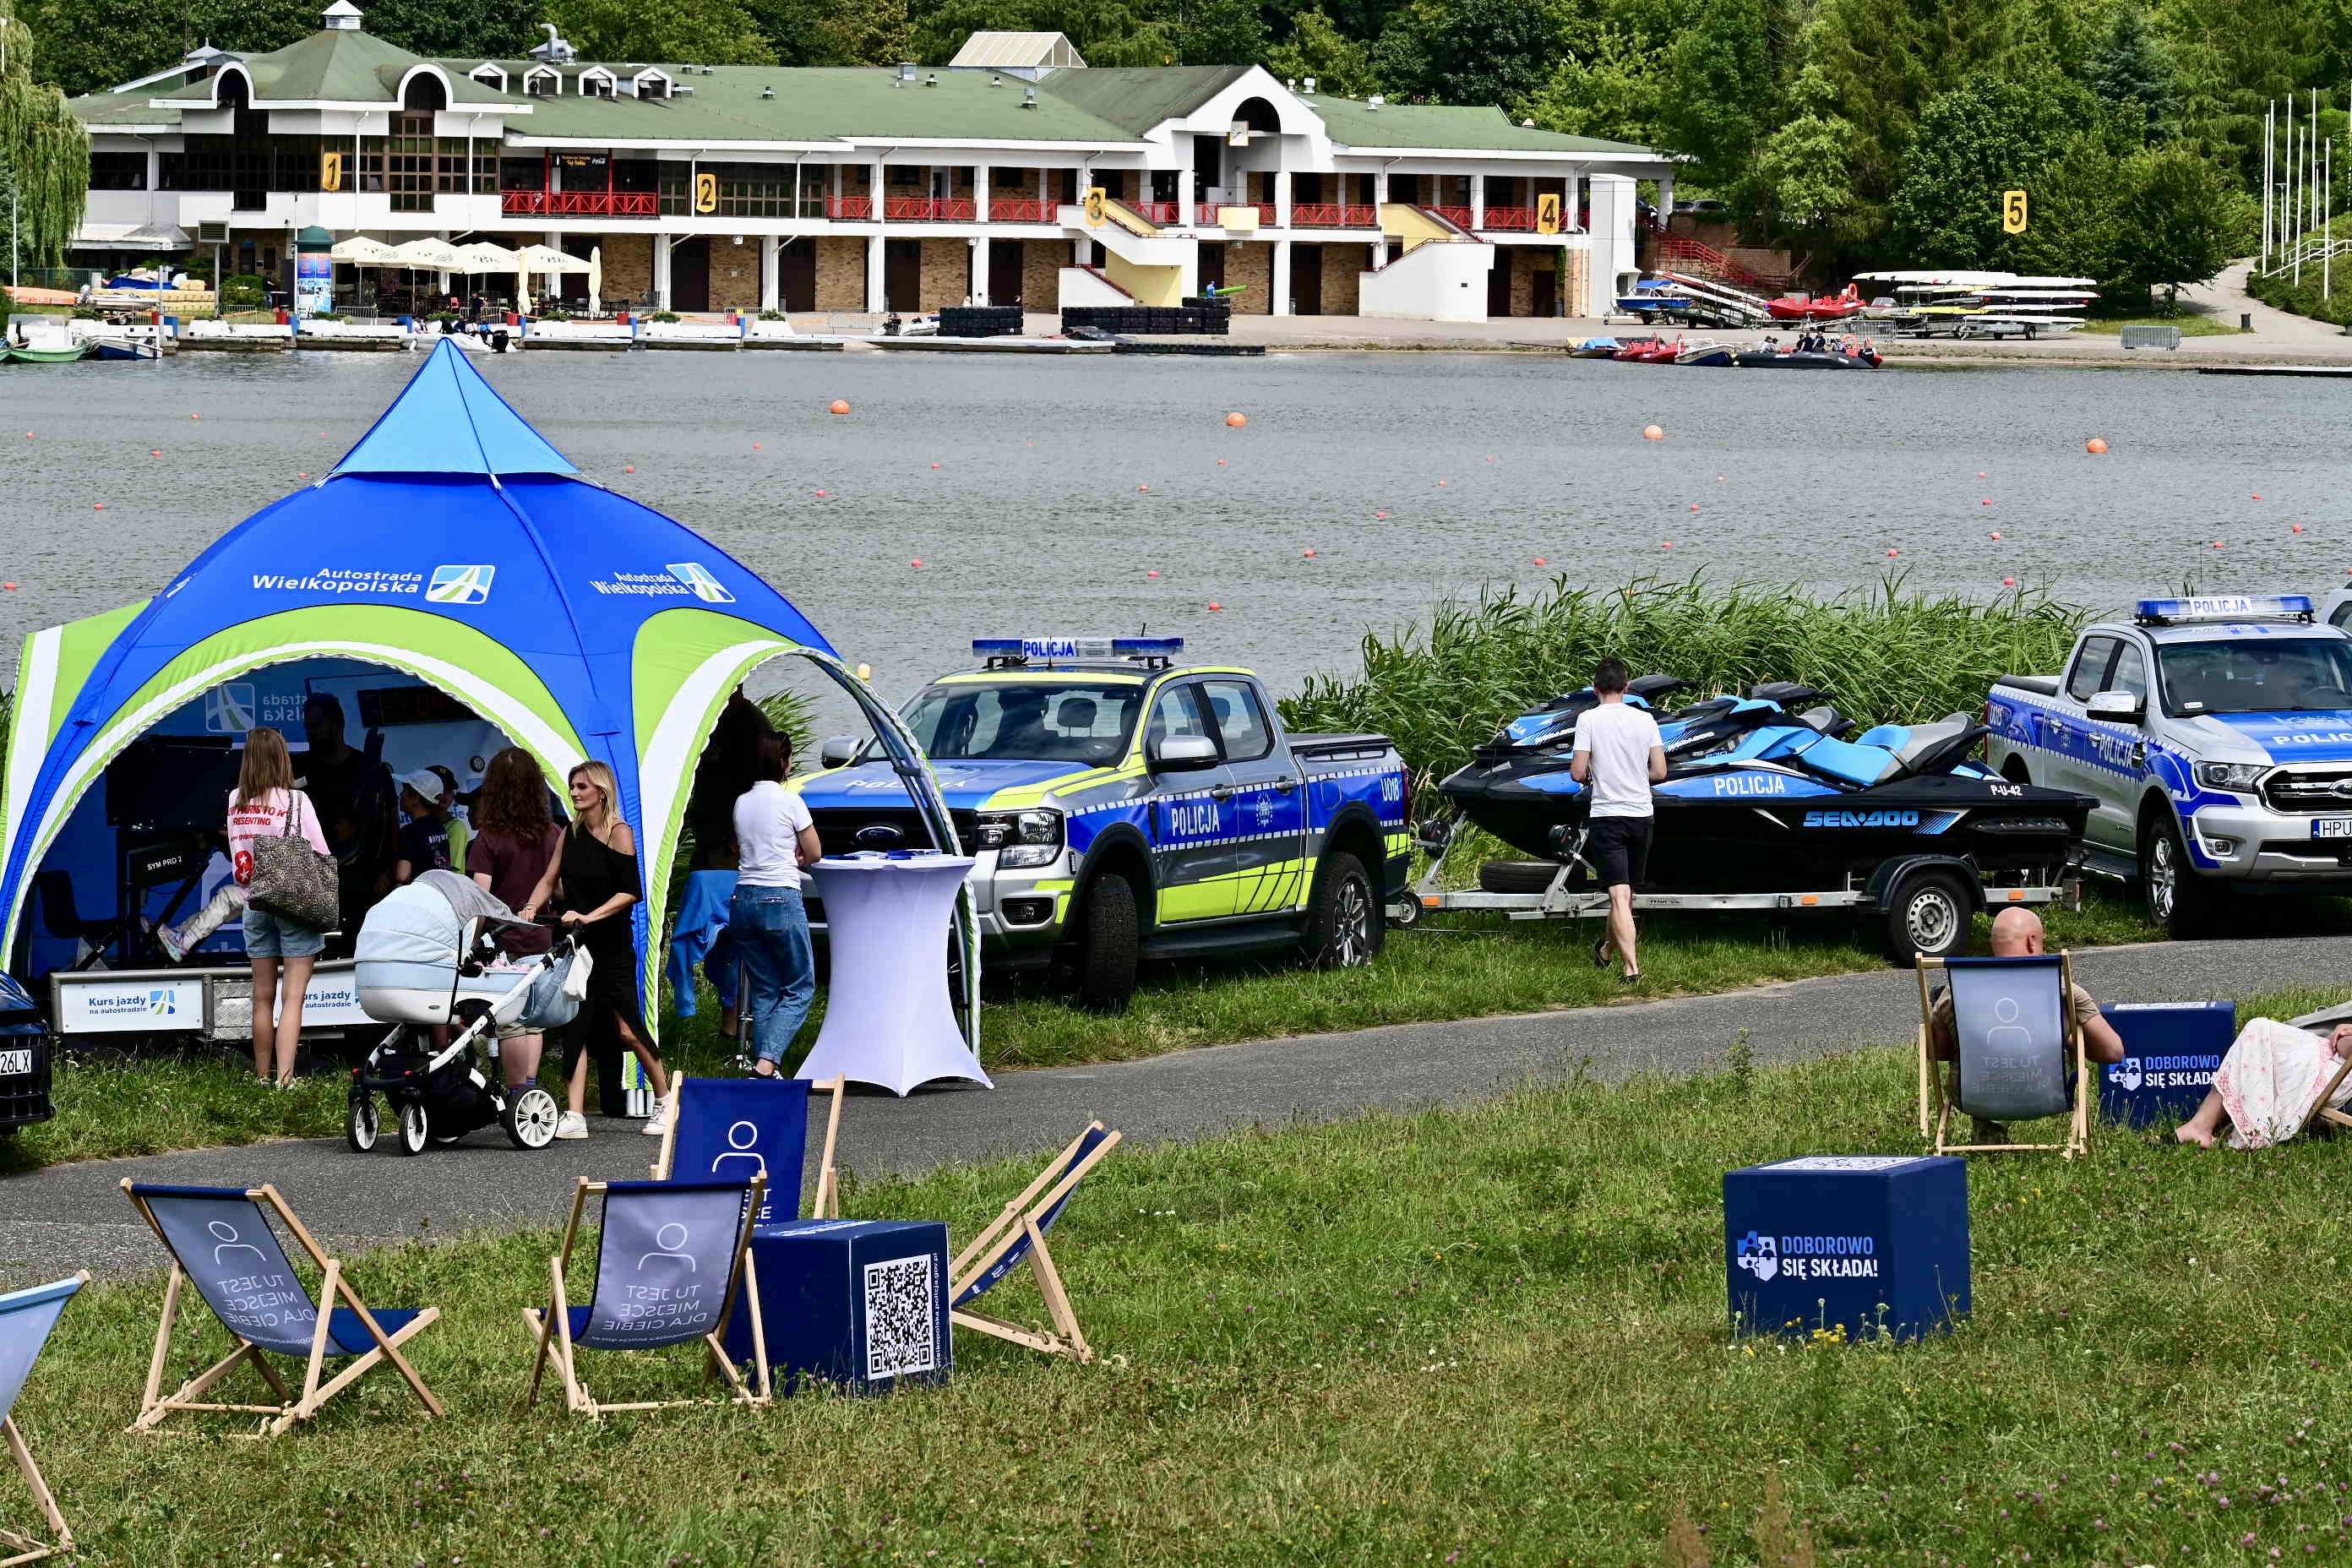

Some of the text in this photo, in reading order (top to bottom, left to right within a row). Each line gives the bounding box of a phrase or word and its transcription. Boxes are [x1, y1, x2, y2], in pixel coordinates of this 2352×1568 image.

[329, 158, 336, 185] 1
[701, 179, 712, 205] 2
[1091, 193, 1102, 220] 3
[1542, 199, 1555, 228] 4
[2010, 197, 2023, 226] 5
[253, 574, 420, 593] Wielkopolska
[317, 568, 422, 582] Autostrada
[613, 572, 677, 583] Autostrada
[589, 580, 690, 597] Wielkopolska
[2194, 600, 2249, 612] POLICJA
[1023, 640, 1075, 656] POLICJA
[2272, 732, 2352, 744] POLIC
[2099, 733, 2136, 770] POLICJA
[1714, 776, 1785, 795] POLICJA
[1990, 784, 2023, 796] P-U-42
[1171, 804, 1220, 836] POLICJA
[2322, 821, 2352, 836] HPU
[147, 861, 161, 870] SYM
[162, 858, 177, 867] PRO
[89, 996, 146, 1007] Kurs jazdy
[321, 991, 351, 1001] jazdy
[1, 1051, 30, 1073] 26LX
[2146, 1055, 2220, 1070] DOBOROWO
[2146, 1072, 2166, 1088] SIĘ
[1782, 1236, 1873, 1255] DOBOROWO
[1782, 1259, 1878, 1280] SIĘ SKŁADA!
